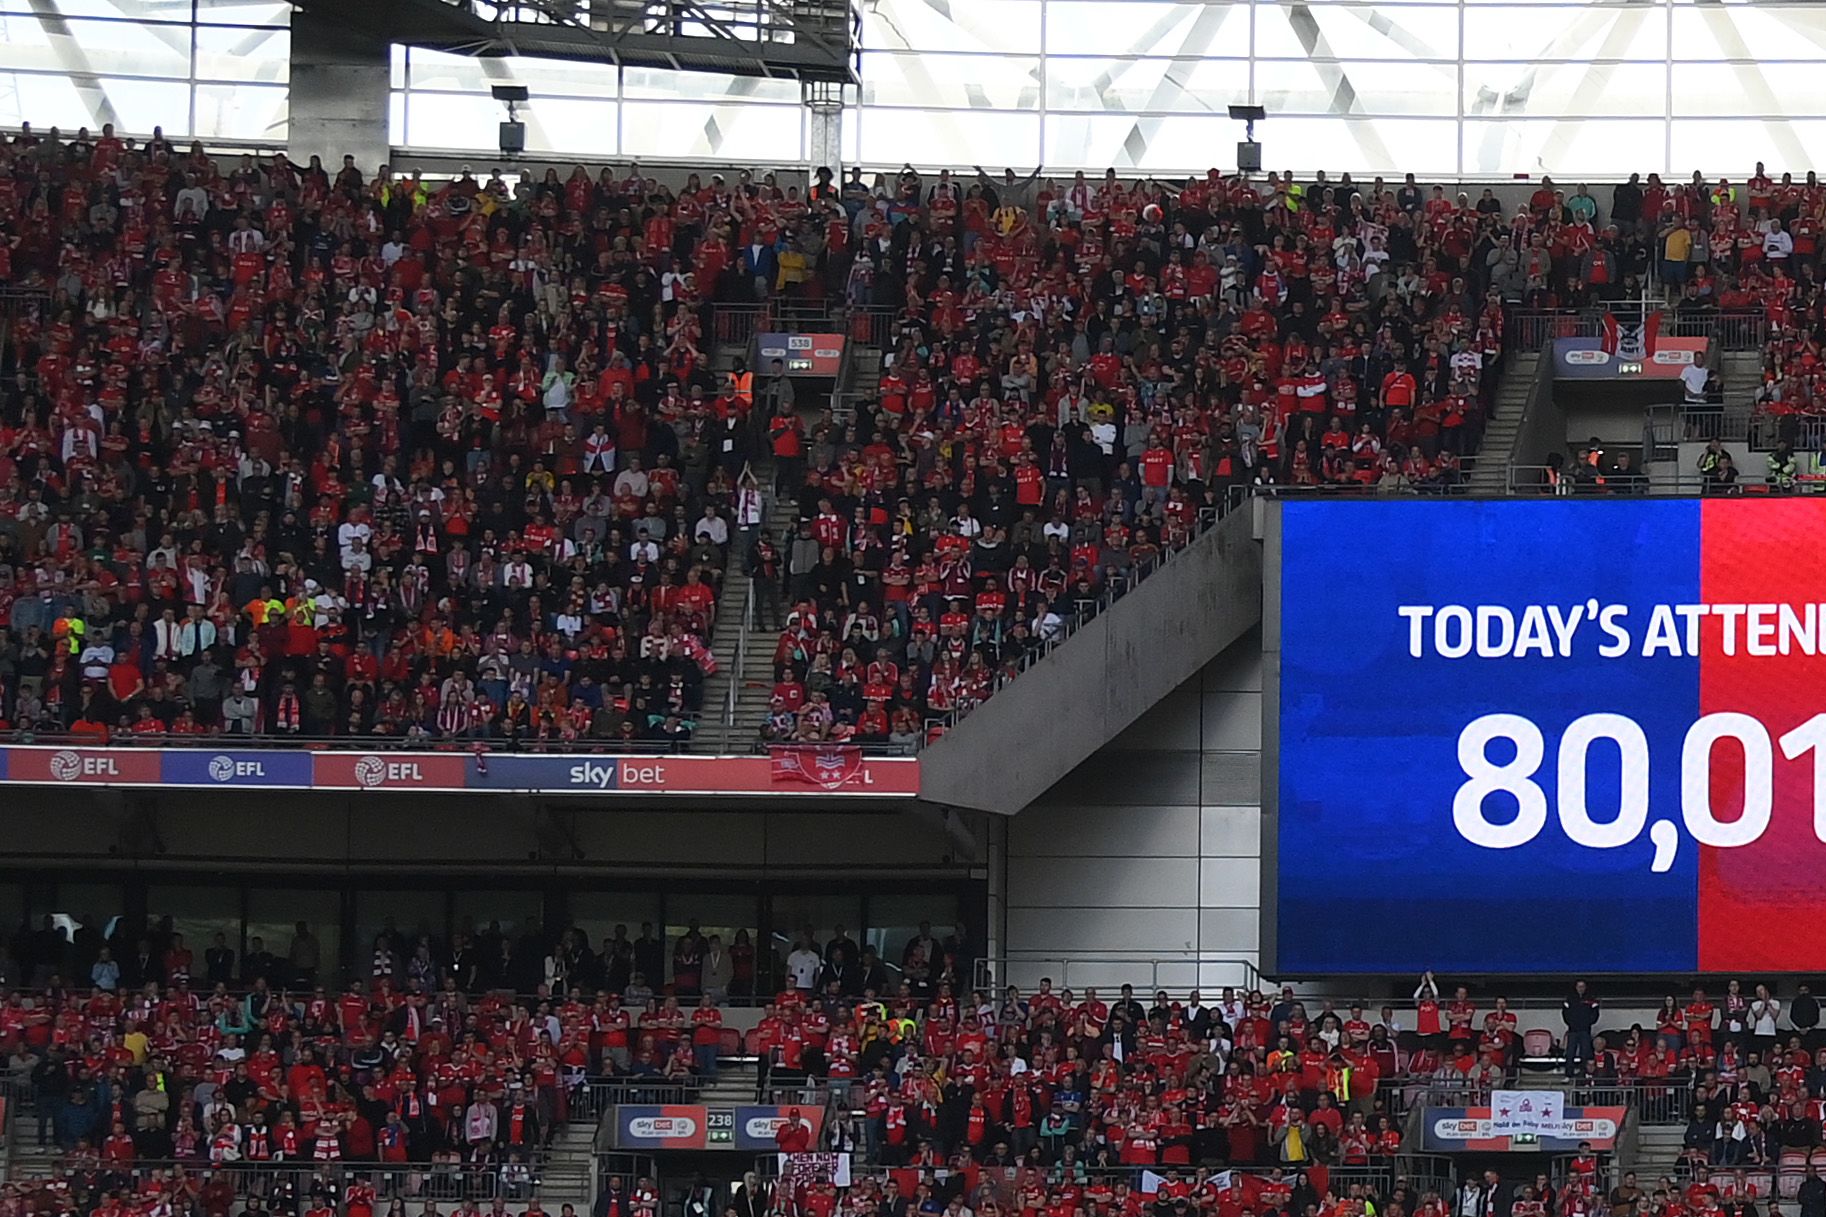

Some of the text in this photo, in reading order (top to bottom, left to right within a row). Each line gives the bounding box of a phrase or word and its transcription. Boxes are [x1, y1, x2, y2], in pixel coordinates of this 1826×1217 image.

[1398, 598, 1630, 658] TODAY'S
[82, 758, 119, 775] EFL
[236, 761, 265, 776] EFL
[387, 762, 422, 780] EFL
[570, 762, 665, 789] sky bet
[637, 1120, 672, 1130] sky bet
[708, 1115, 732, 1126] 238
[753, 1120, 770, 1130] sky
[1442, 1122, 1476, 1131] sky bet
[1577, 1122, 1593, 1130] bet
